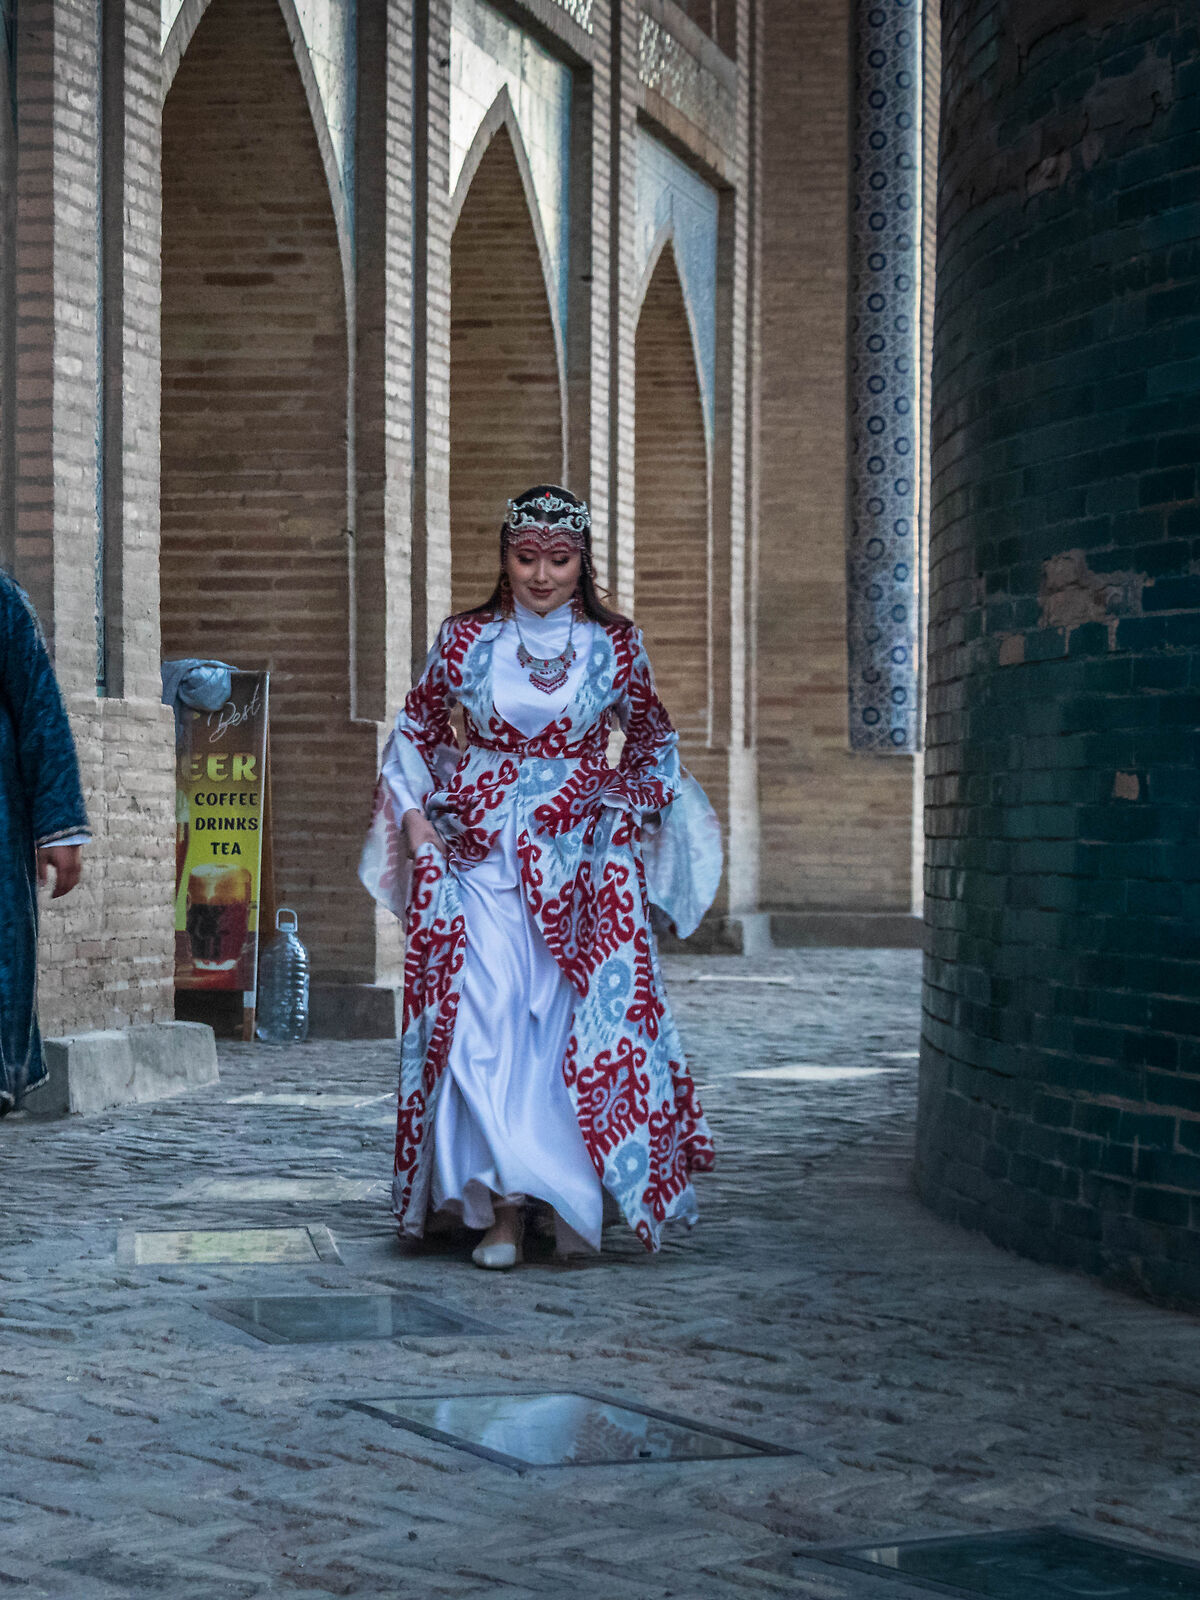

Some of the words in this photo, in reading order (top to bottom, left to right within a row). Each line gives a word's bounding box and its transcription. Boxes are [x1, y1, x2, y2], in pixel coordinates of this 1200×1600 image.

[207, 683, 261, 743] Best
[180, 752, 258, 781] EER
[194, 792, 258, 806] COFFEE
[195, 817, 259, 831] DRINKS
[210, 842, 242, 855] TEA
